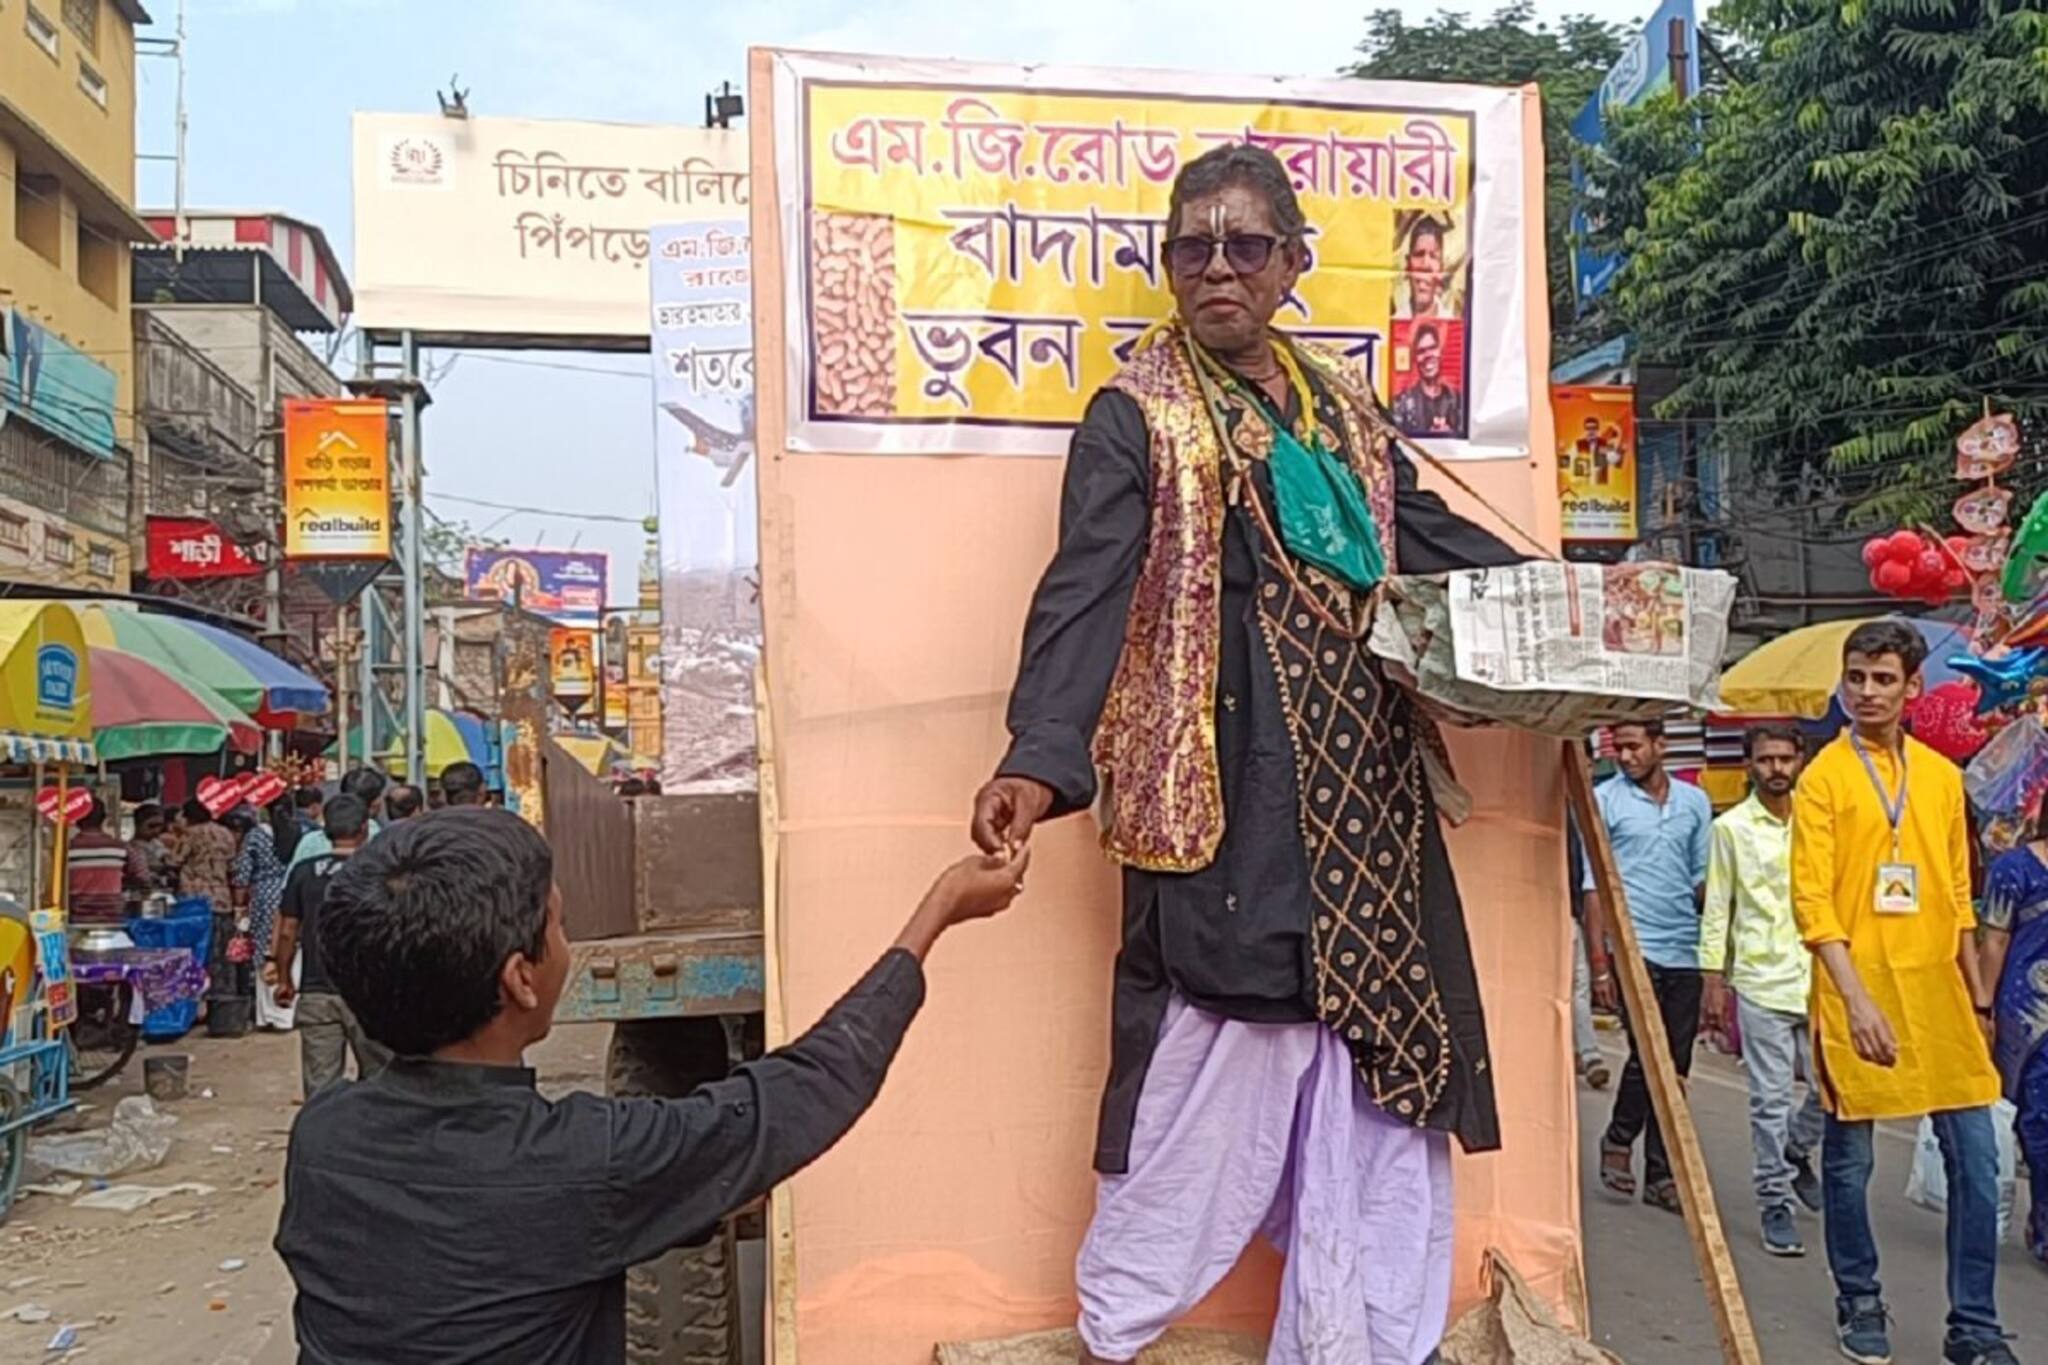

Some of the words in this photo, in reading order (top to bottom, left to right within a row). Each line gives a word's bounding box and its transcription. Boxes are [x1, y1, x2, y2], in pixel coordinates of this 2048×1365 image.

[832, 97, 1177, 187] এম.জি.রোড
[492, 149, 630, 198] চিনিতে
[902, 313, 1084, 408] ভুবন
[299, 516, 381, 532] realbuild
[1561, 497, 1631, 513] realbuild
